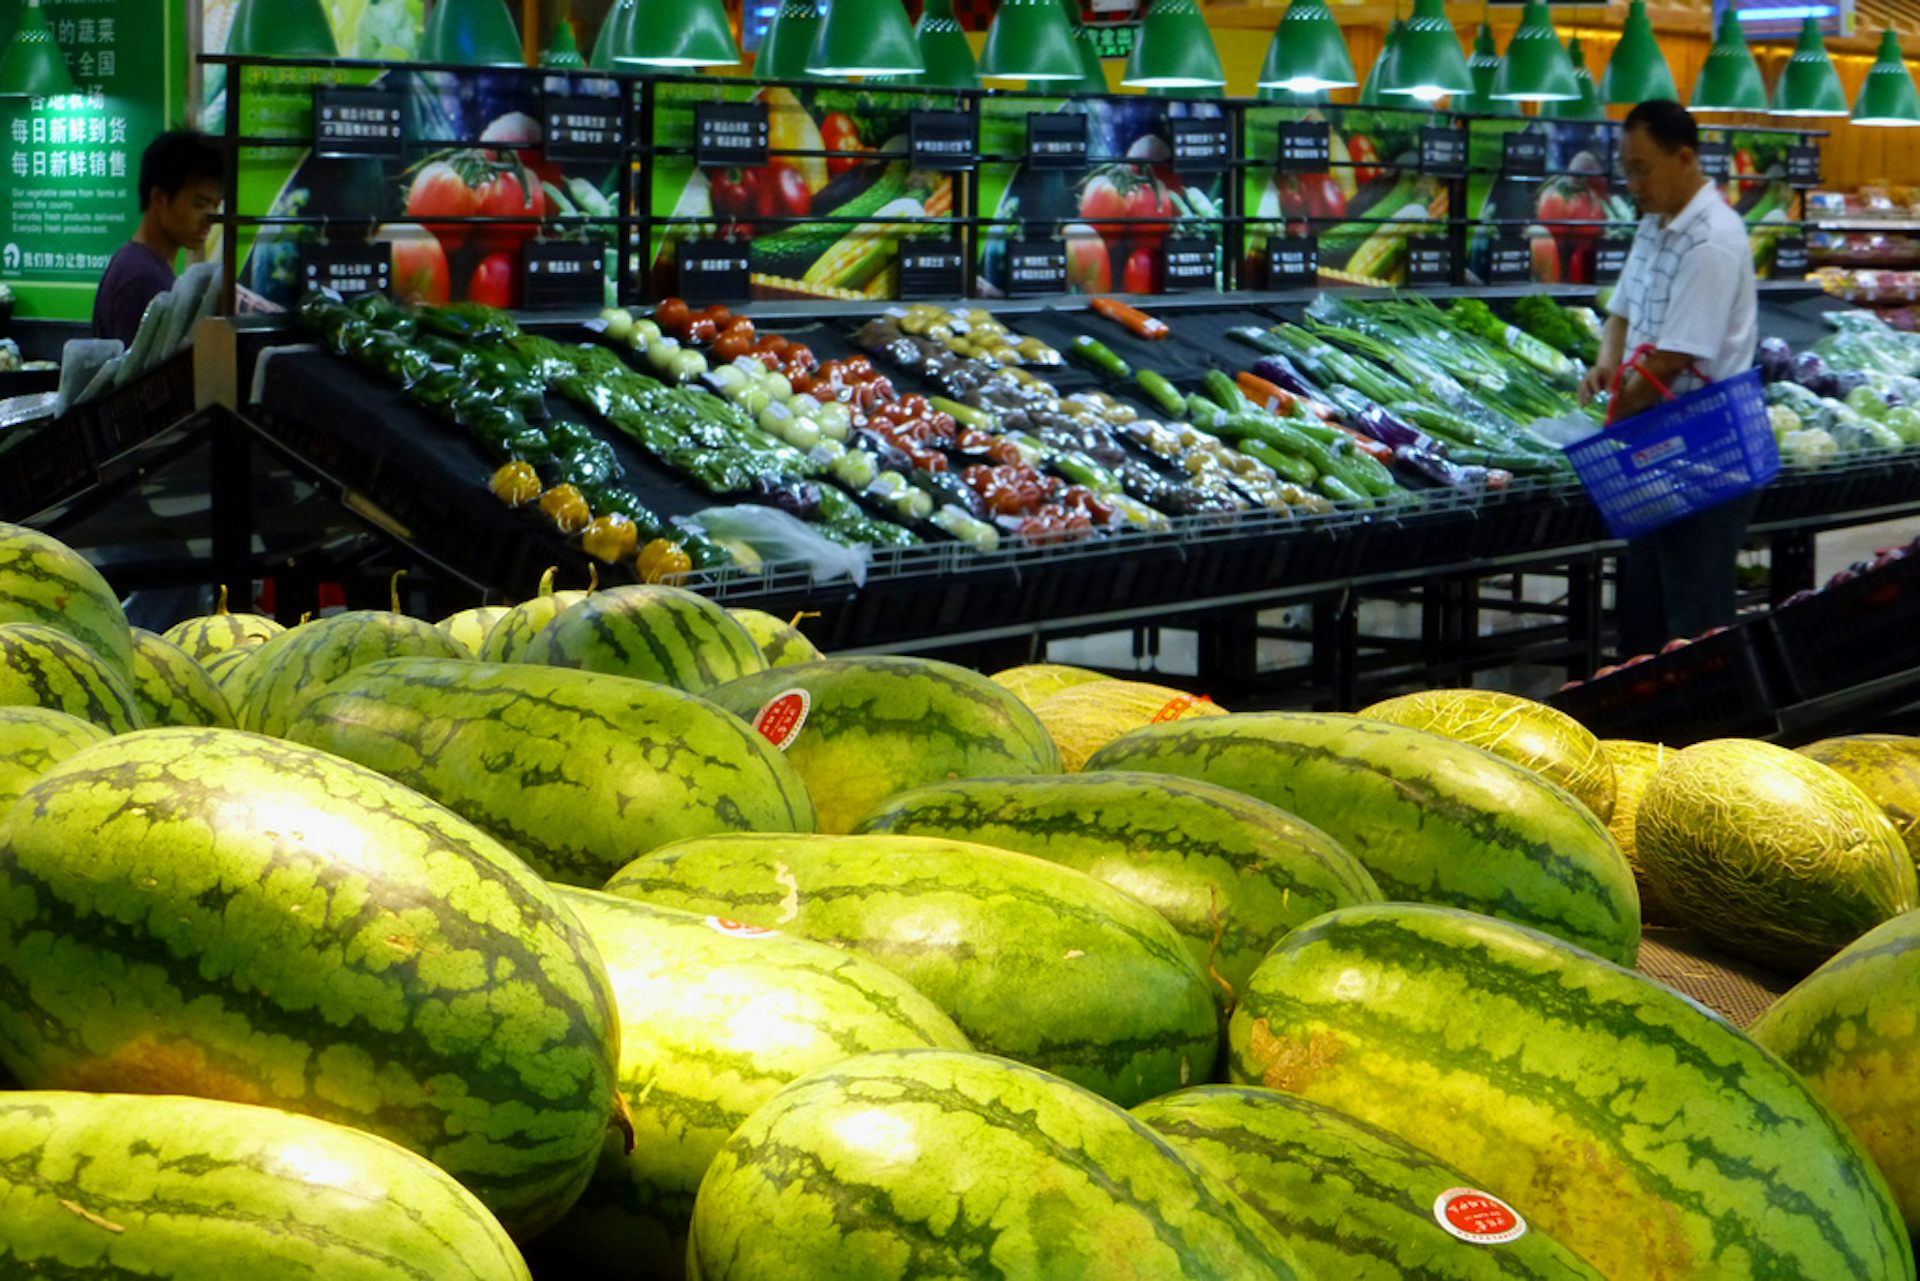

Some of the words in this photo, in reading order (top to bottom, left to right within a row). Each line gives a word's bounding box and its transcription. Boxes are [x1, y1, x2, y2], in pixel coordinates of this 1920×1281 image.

[11, 117, 127, 144] 每日新鲜到货
[11, 151, 127, 178] 每日新鲜销售
[36, 200, 47, 209] the
